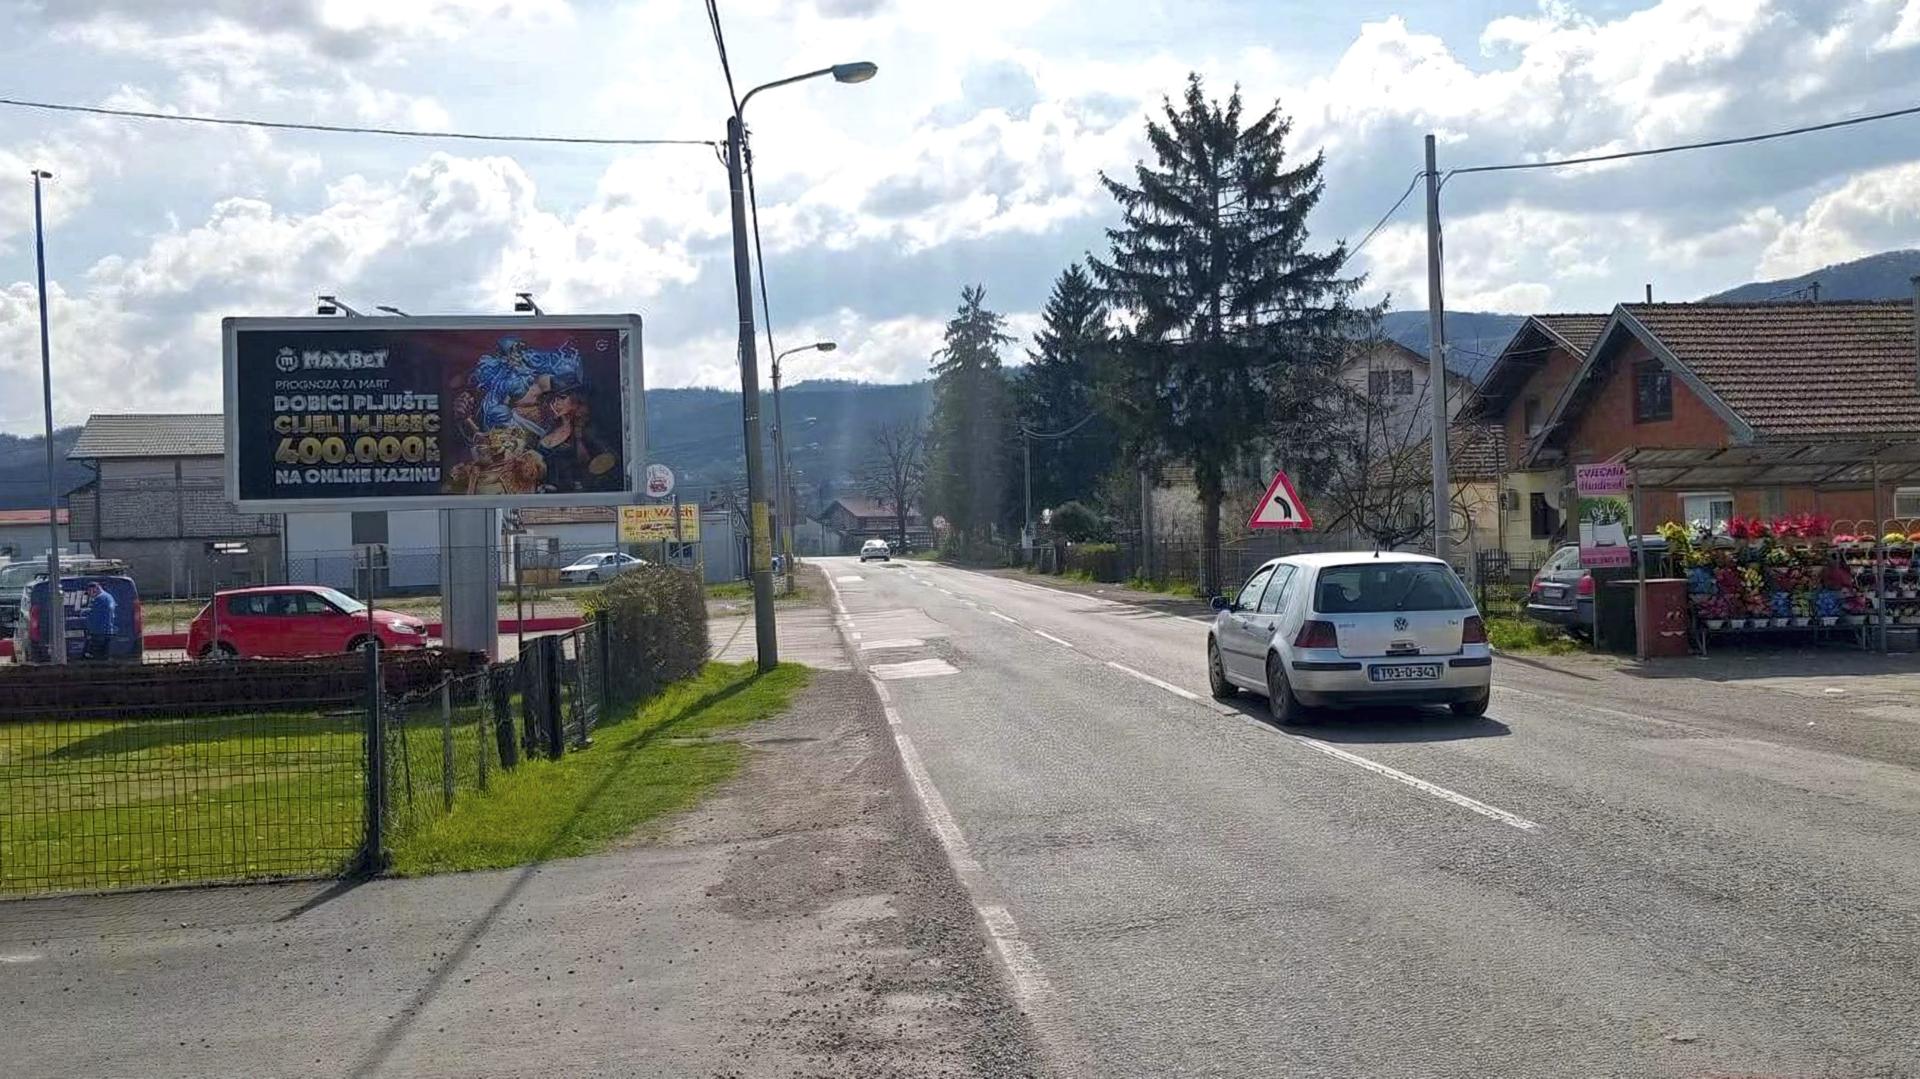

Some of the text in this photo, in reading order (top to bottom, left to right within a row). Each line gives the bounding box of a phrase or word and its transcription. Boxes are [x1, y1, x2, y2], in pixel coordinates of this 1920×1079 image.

[275, 379, 390, 390] PROGNOZA ZA MART
[274, 391, 439, 411] DOBICI PLJUŠTE
[274, 414, 440, 433] CIJELI MJESEC
[275, 436, 425, 464] 400.000
[275, 467, 440, 484] NA ONLINE KAZINU
